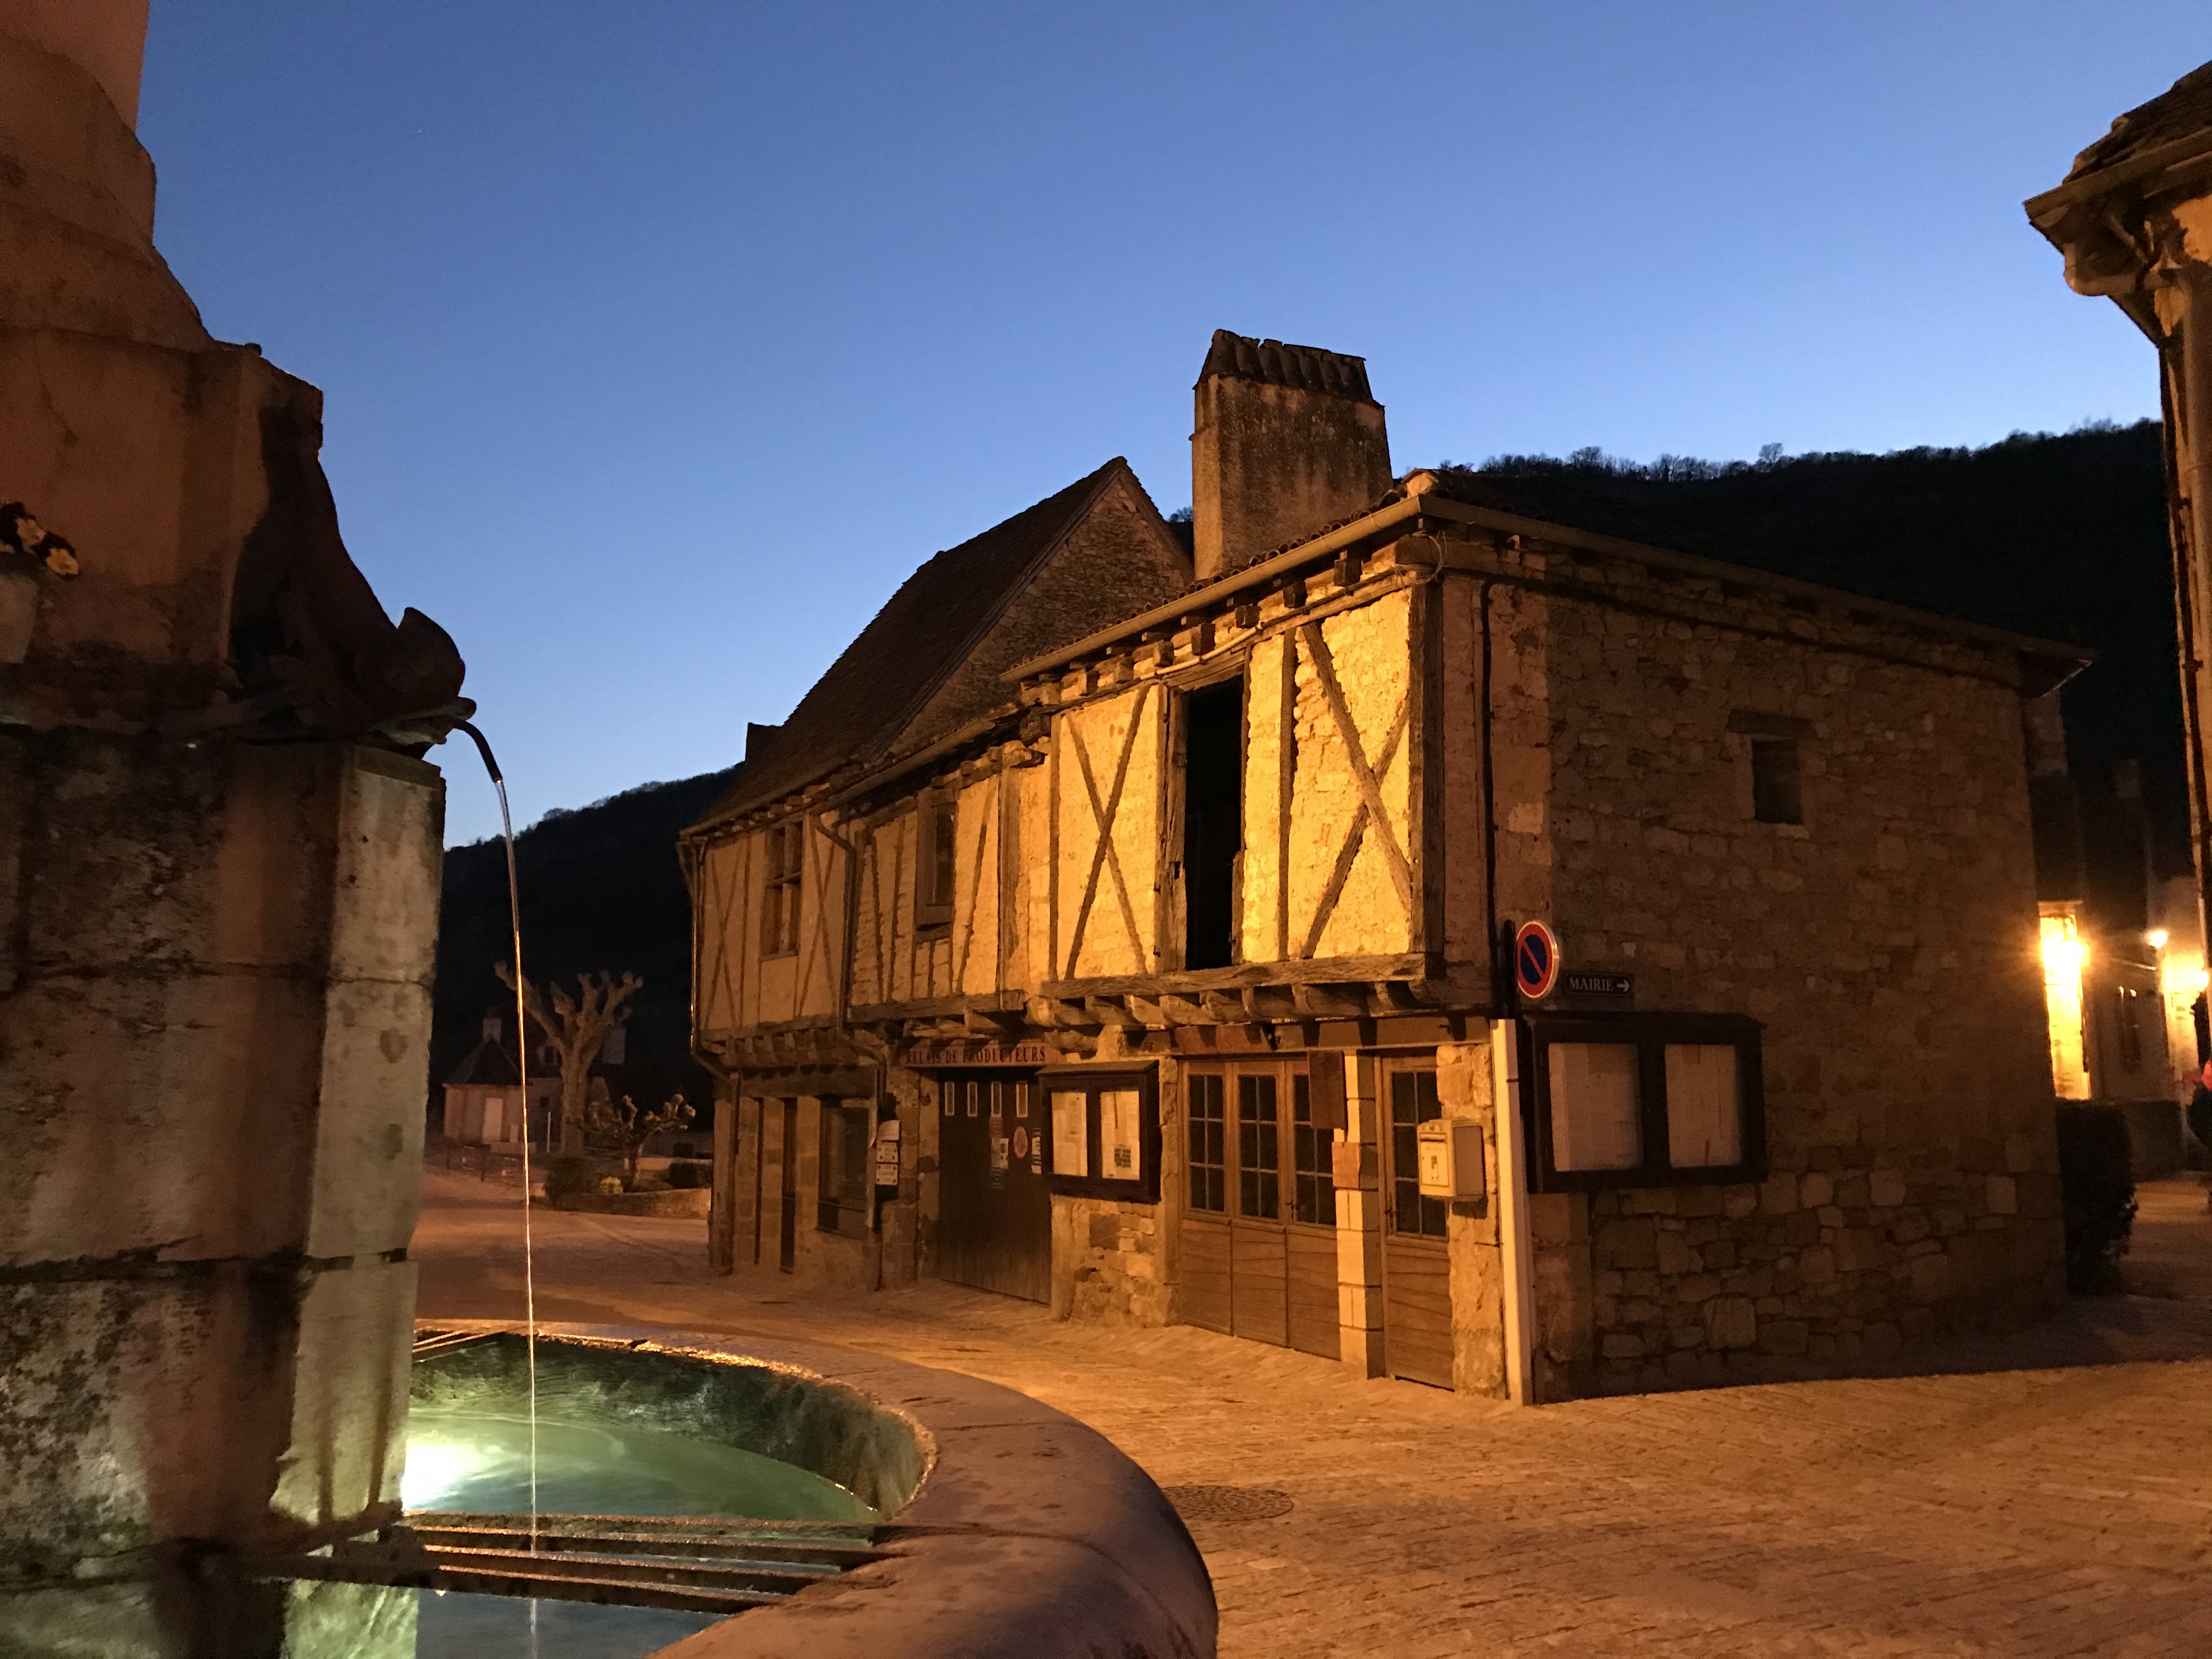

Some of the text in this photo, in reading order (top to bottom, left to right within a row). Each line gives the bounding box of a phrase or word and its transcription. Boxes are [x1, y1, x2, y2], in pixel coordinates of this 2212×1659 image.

[1570, 977, 1613, 991] MAIRIE
[906, 1046, 1046, 1064] RELAIS DE PRODUCTEURS
